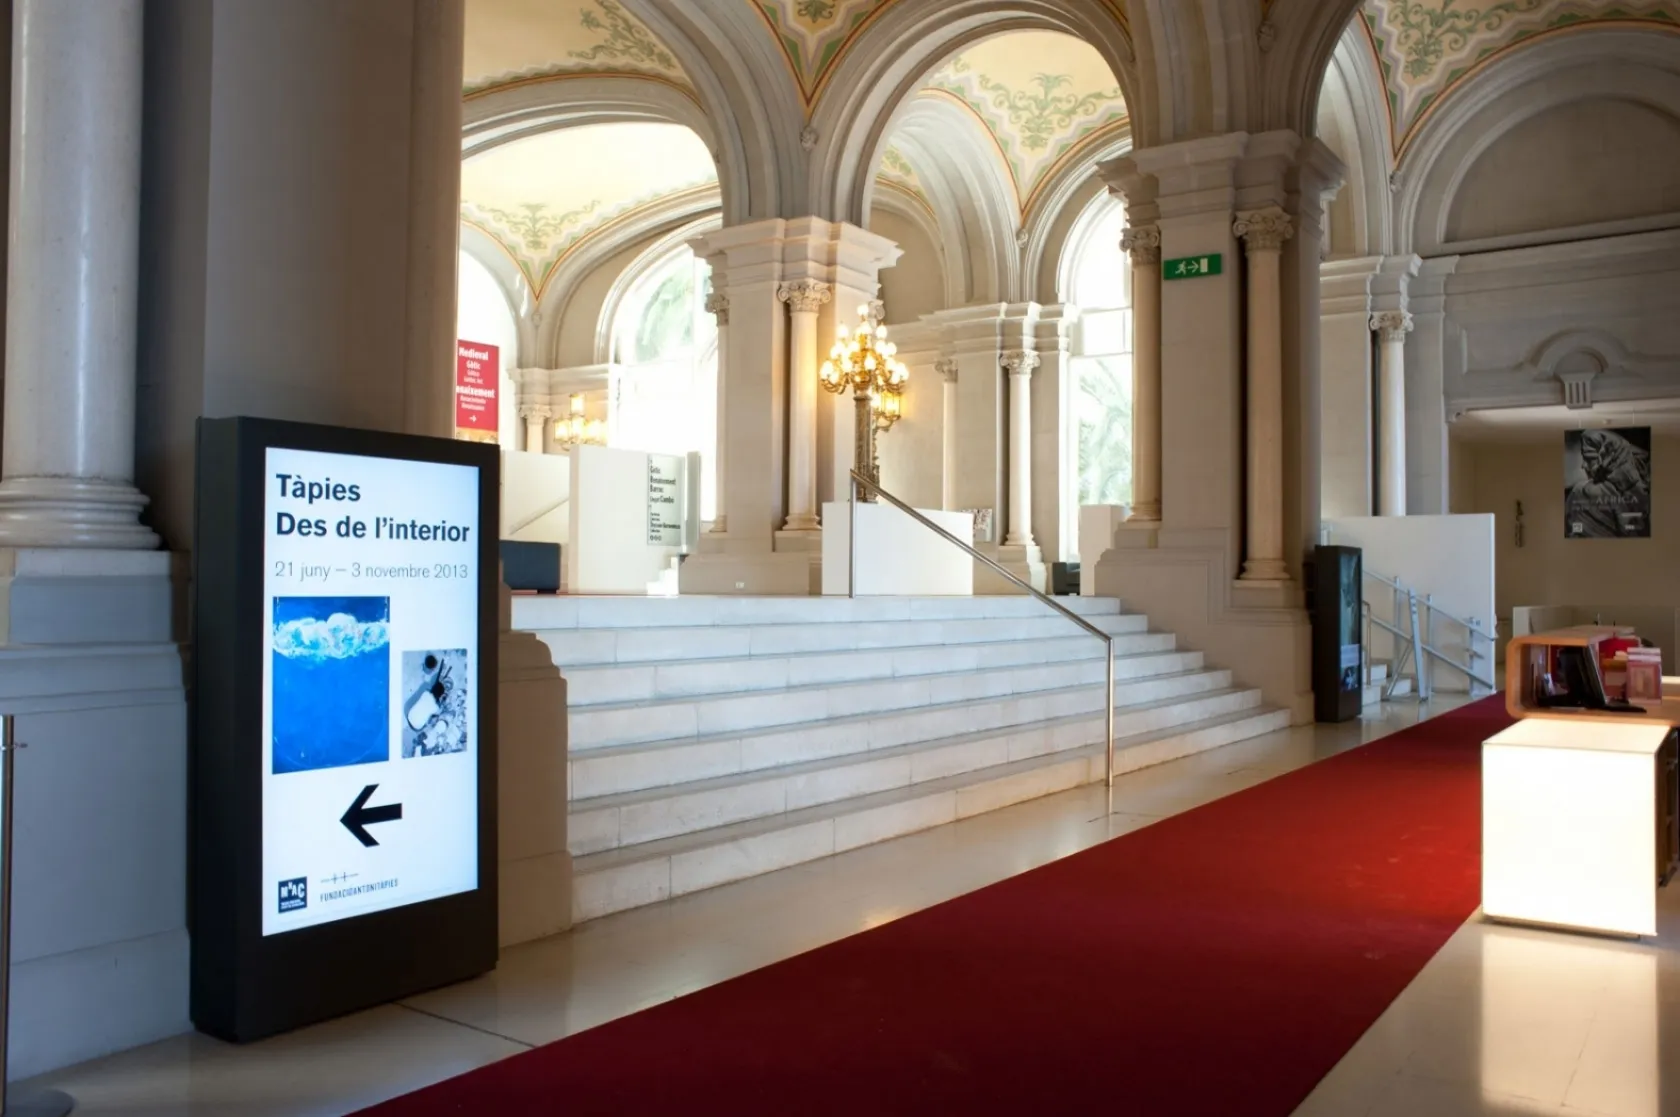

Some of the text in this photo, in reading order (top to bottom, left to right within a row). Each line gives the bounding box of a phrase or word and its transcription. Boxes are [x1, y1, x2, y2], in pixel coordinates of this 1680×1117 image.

[456, 385, 496, 398] enaixement
[276, 473, 361, 504] Tàpies
[276, 511, 327, 537] Des
[336, 515, 367, 538] de
[275, 560, 294, 577] 21
[299, 561, 331, 582] juny
[351, 562, 361, 578] 3
[365, 564, 430, 579] novembre
[434, 564, 468, 579] 2013
